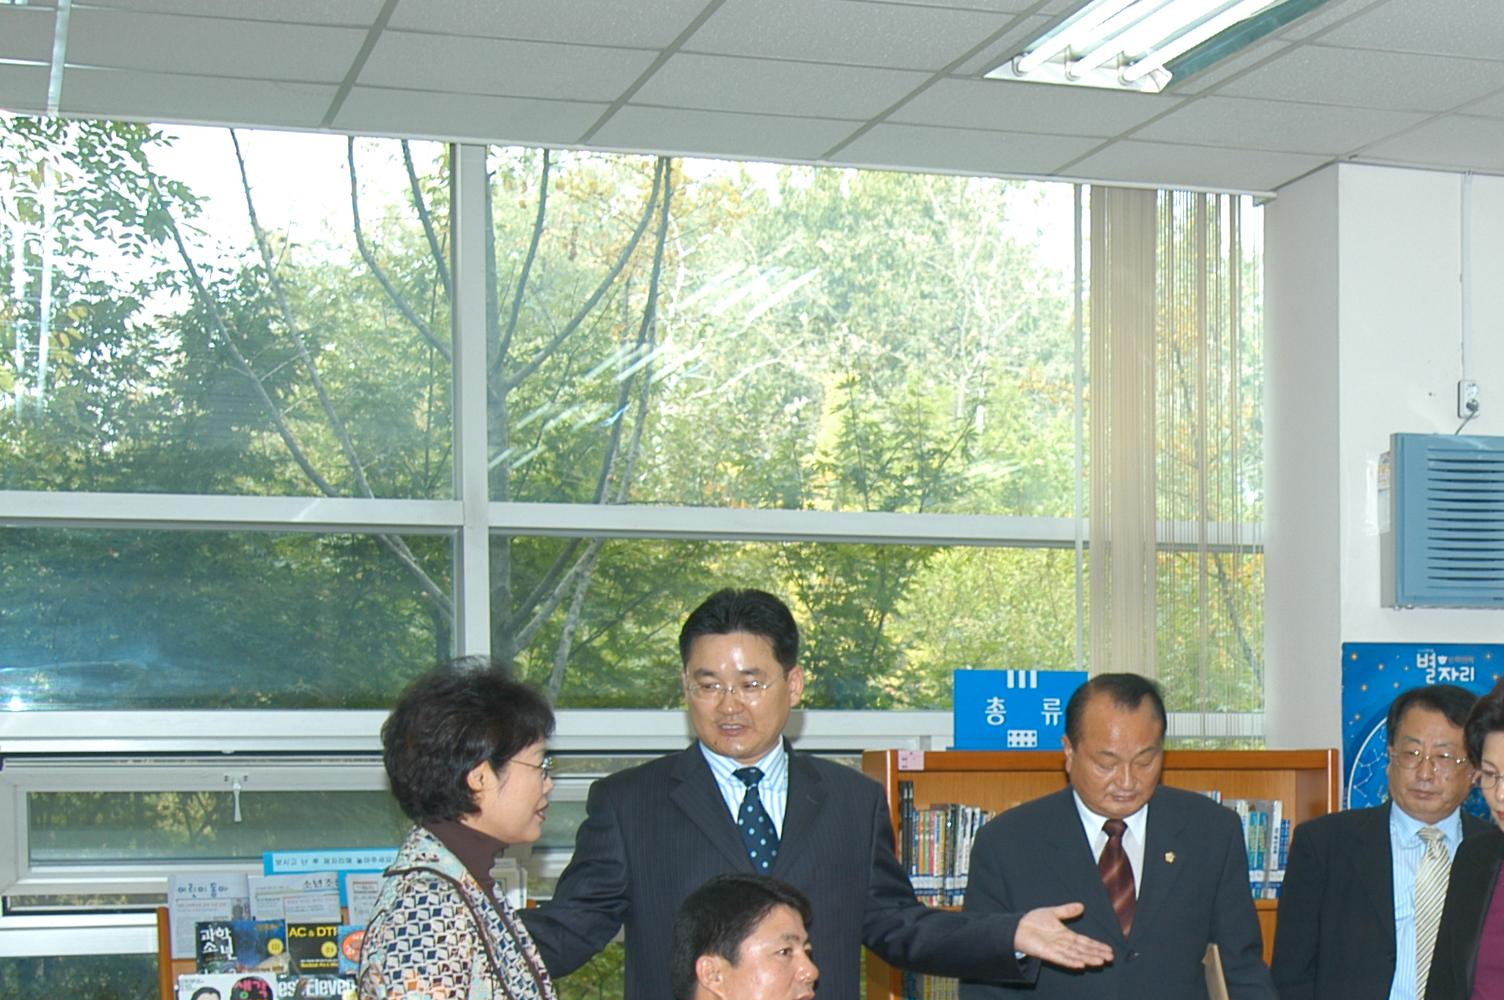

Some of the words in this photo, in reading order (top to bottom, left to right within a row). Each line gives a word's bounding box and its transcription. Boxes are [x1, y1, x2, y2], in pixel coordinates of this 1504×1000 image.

[1416, 652, 1475, 684] 별자리
[984, 696, 1063, 726] 총류
[200, 924, 232, 942] 과학
[288, 927, 306, 938] AC
[202, 937, 238, 961] 소년
[278, 980, 298, 998] es
